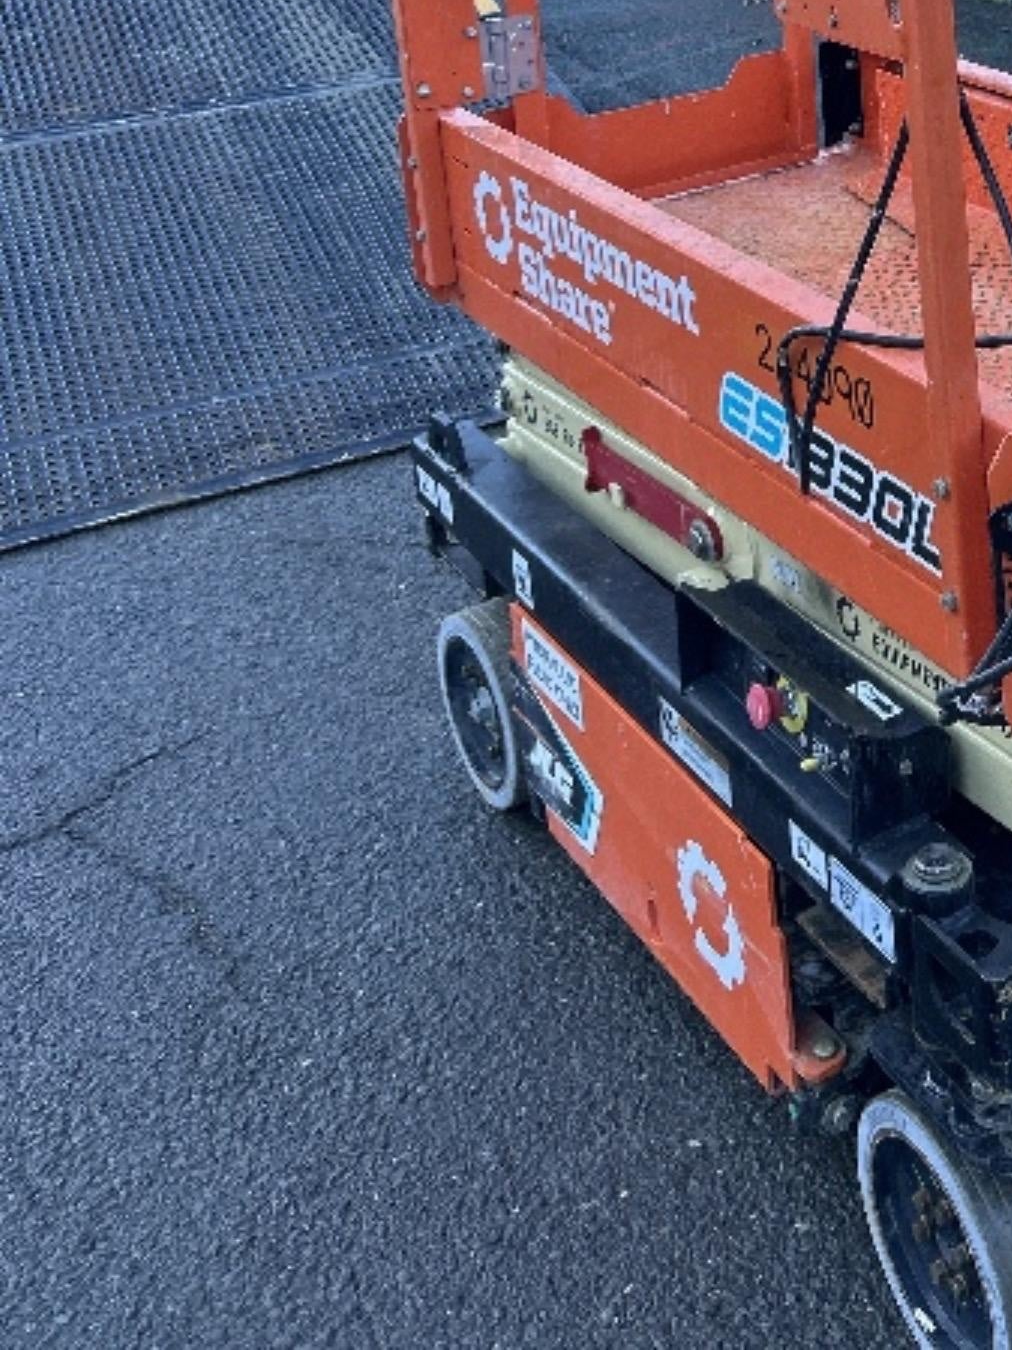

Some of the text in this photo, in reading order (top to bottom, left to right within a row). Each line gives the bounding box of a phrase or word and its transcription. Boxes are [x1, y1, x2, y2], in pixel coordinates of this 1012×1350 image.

[509, 176, 700, 337] Equipment
[517, 242, 614, 346] Share
[719, 370, 943, 580] ES330L
